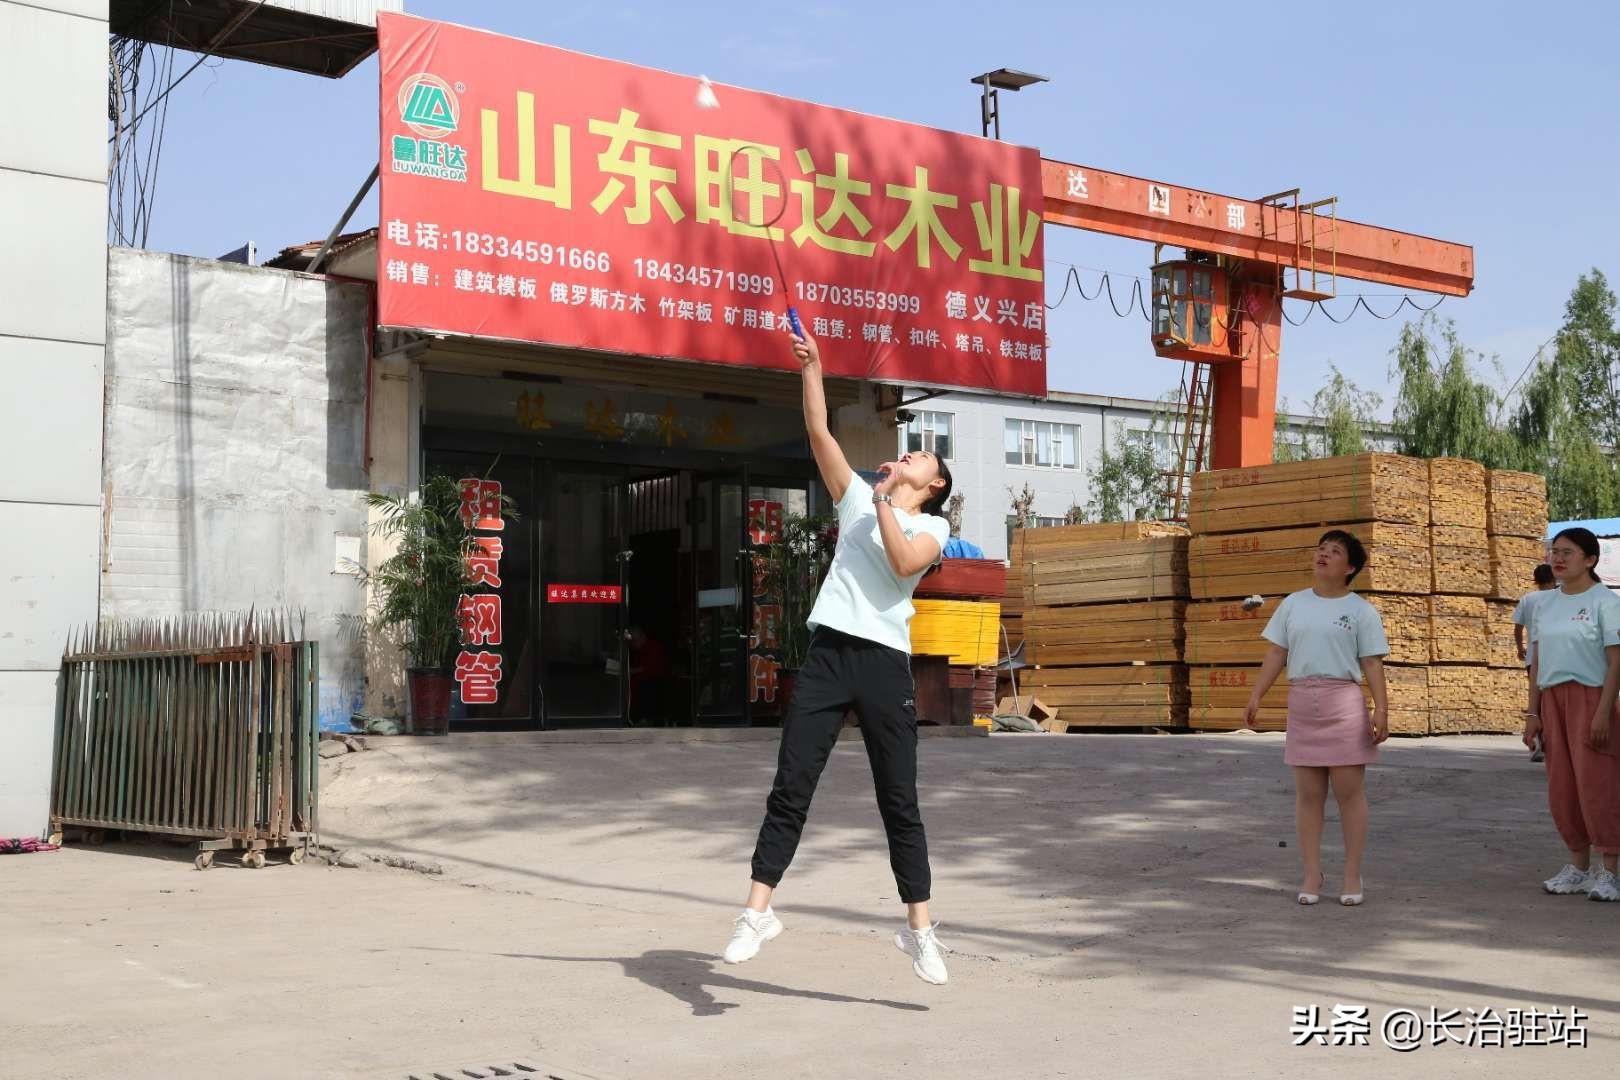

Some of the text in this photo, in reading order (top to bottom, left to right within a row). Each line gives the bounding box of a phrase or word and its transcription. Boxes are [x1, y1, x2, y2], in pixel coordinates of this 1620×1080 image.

[392, 135, 467, 170] 鲁旺达
[392, 160, 467, 182] LUWANGDA
[480, 90, 1044, 283] 山东旺达木业
[453, 267, 538, 300] 建筑模板
[549, 280, 647, 314] 俄罗斯方木
[658, 296, 713, 323] 竹架板
[723, 304, 793, 333] 矿用道木
[633, 257, 774, 296] 18434571999
[795, 280, 921, 314] 18703553999
[944, 289, 1044, 331] 德义兴店
